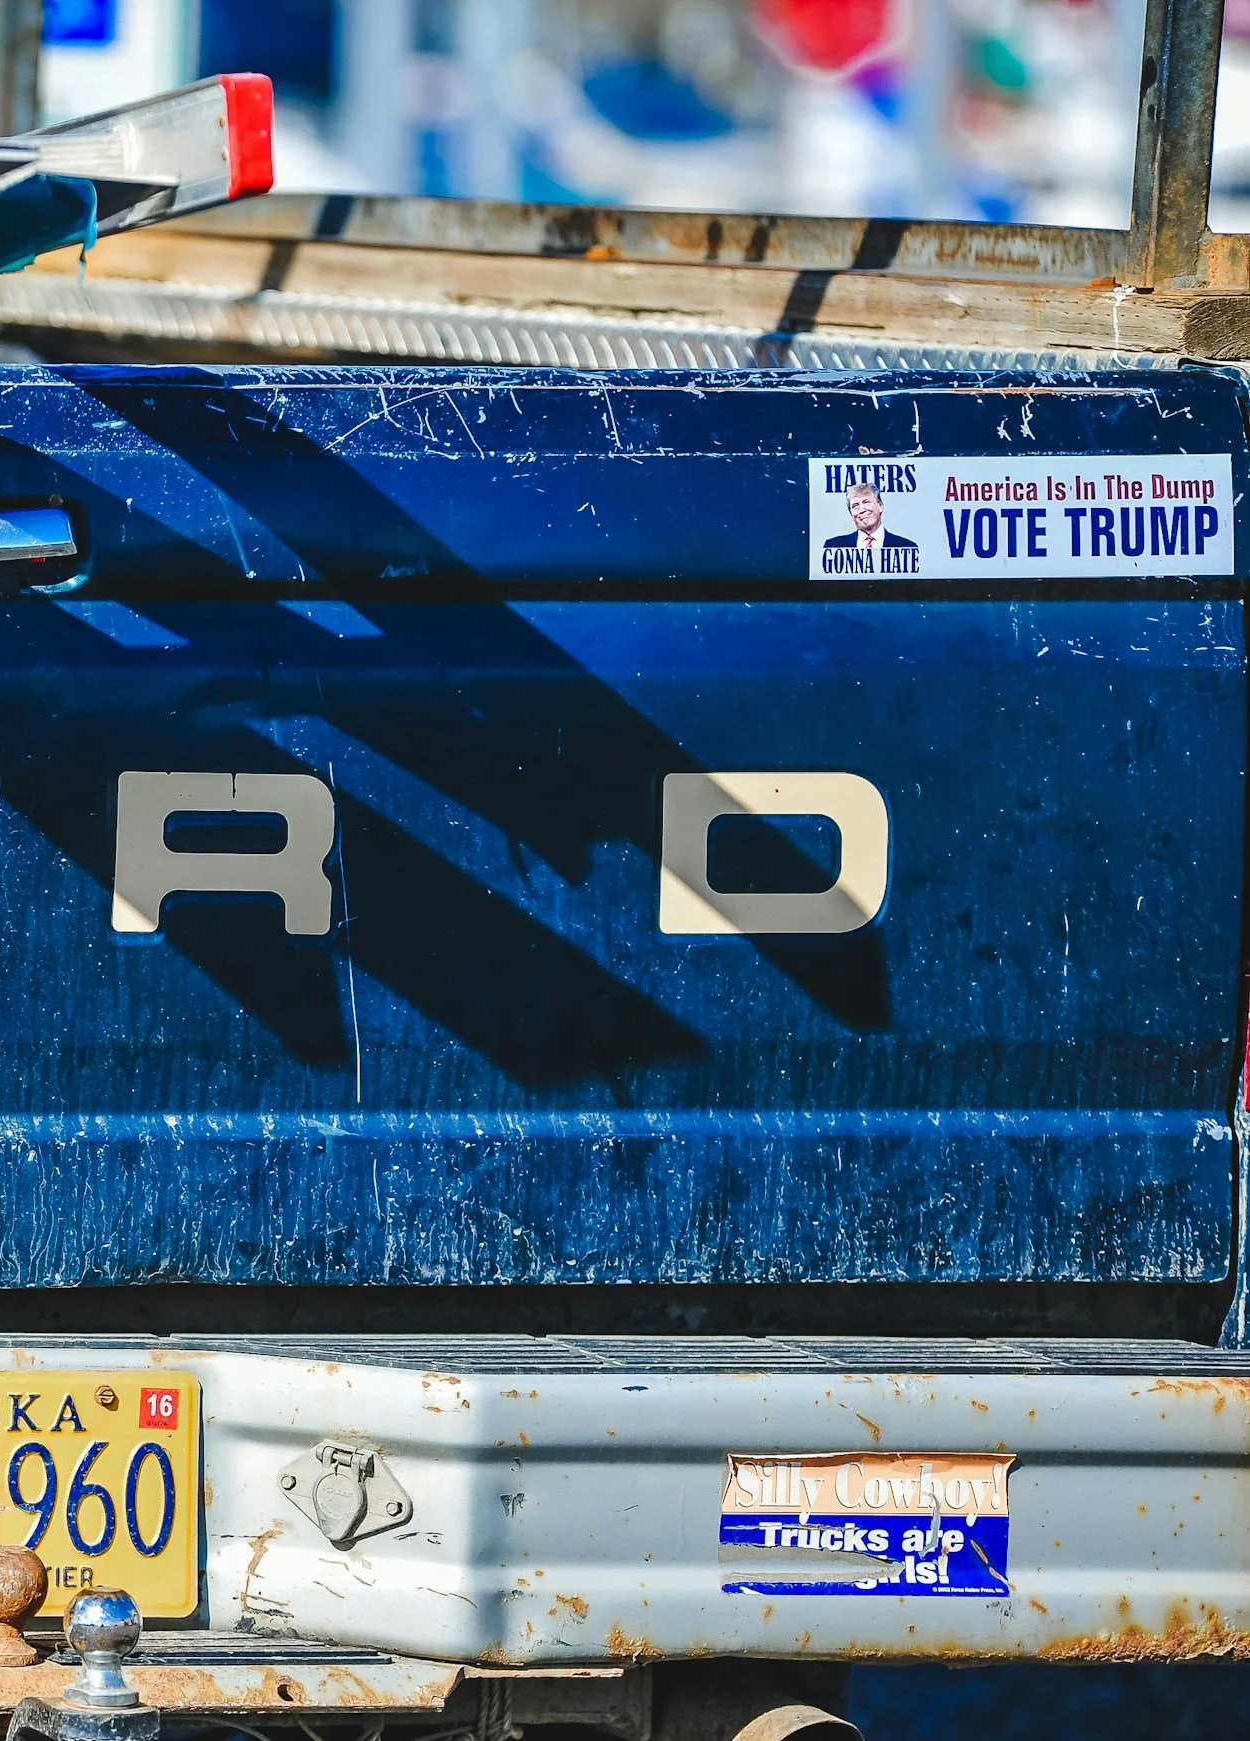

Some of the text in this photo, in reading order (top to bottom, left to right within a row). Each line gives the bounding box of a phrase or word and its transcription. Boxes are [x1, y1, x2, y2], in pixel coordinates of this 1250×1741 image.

[825, 464, 917, 493] HATERS
[945, 473, 1216, 505] America Is In The Dump
[943, 506, 1220, 558] VOTE TRUMP
[822, 548, 920, 574] GONNA HATE
[147, 1393, 173, 1417] 16
[7, 1441, 177, 1557] 960
[735, 1460, 1003, 1527] Silly Cowboy!
[759, 1522, 889, 1552] Trucks
